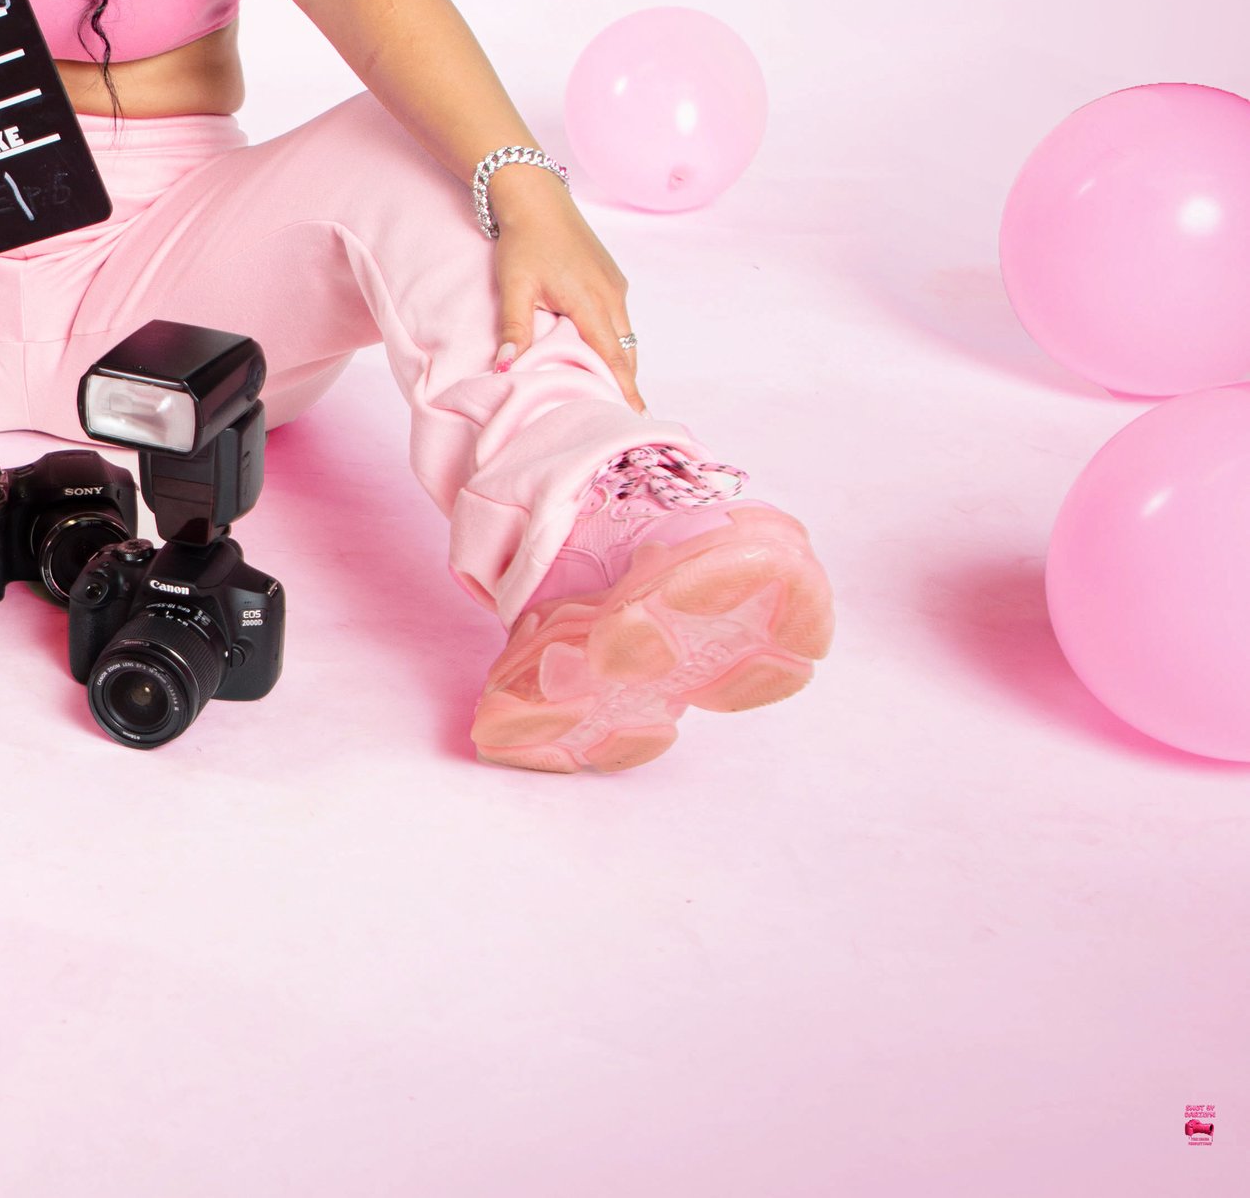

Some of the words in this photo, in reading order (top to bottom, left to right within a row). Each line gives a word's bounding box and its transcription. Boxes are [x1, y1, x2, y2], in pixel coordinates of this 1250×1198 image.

[64, 486, 104, 496] SONY
[150, 579, 190, 596] Canon
[243, 609, 262, 619] EOS
[242, 619, 264, 627] 2000D
